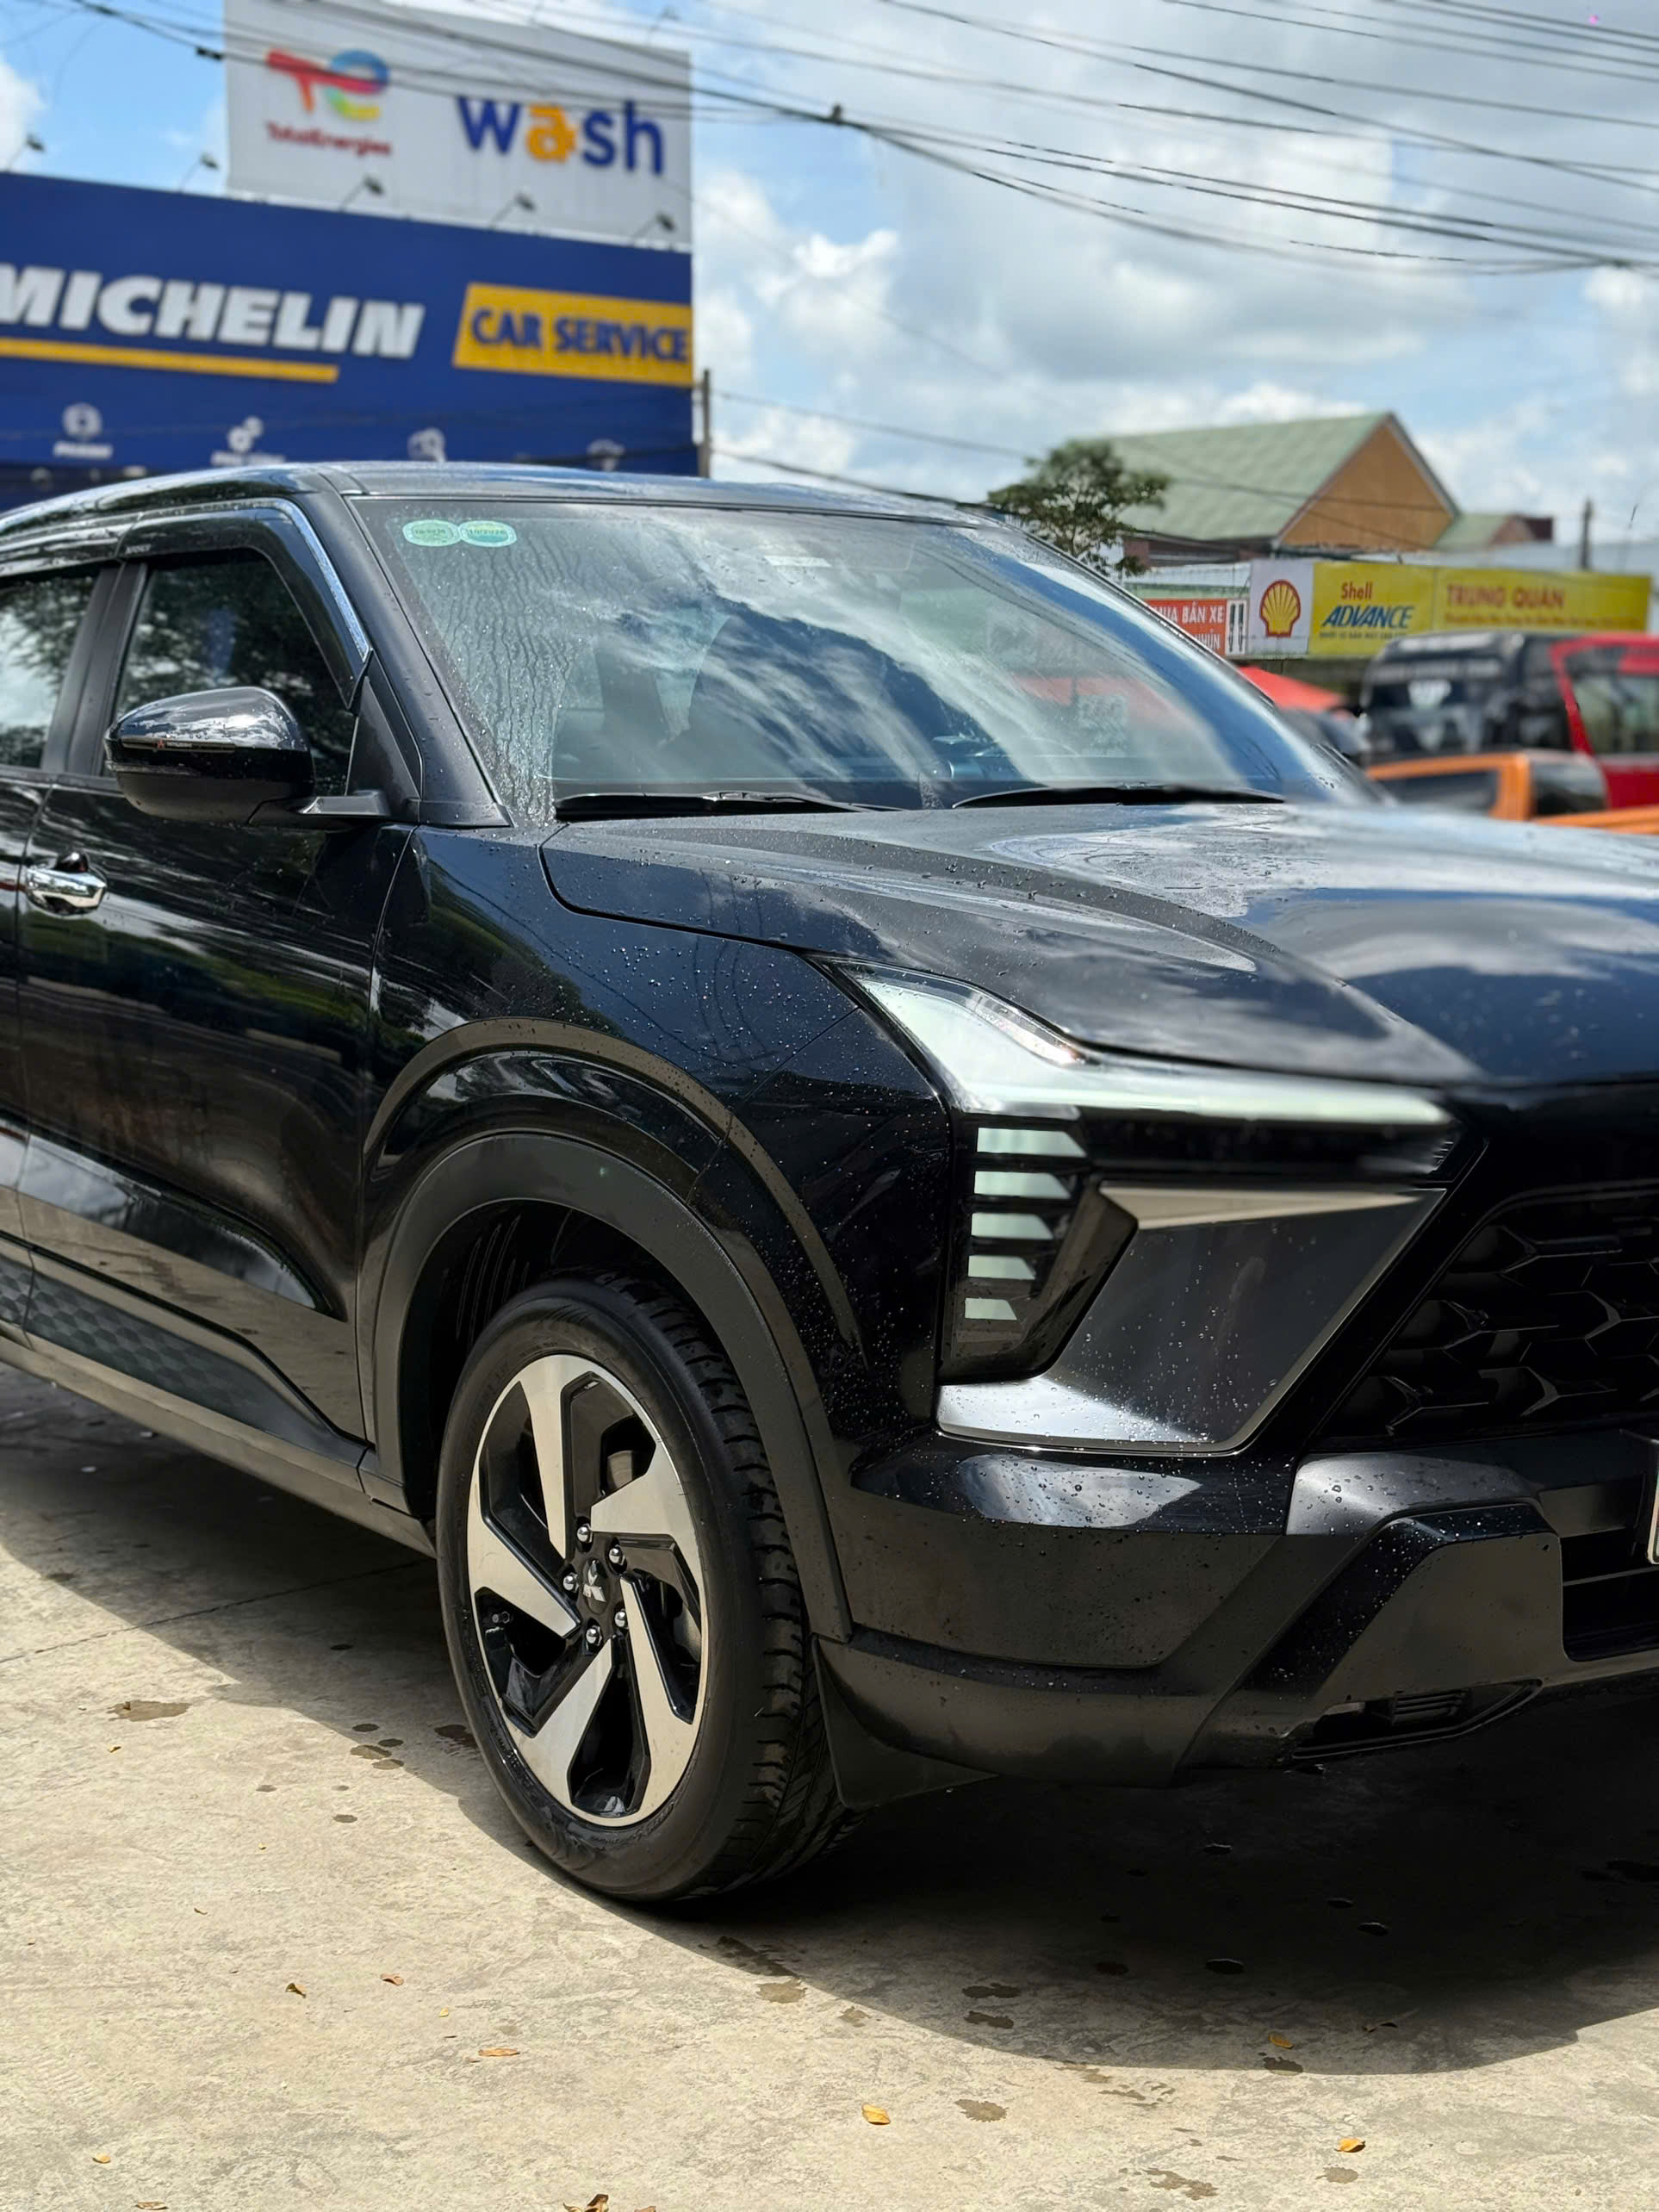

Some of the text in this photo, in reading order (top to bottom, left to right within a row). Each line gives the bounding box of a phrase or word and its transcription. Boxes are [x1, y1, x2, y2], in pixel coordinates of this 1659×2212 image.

[267, 121, 392, 157] TotalEnergies
[456, 96, 664, 176] wash
[0, 263, 425, 359] MICHELIN
[472, 308, 689, 362] CAR SERVICE
[1341, 581, 1372, 600] Shell
[1154, 601, 1225, 624] UA BÁN XE
[1321, 605, 1415, 628] ADVANCE
